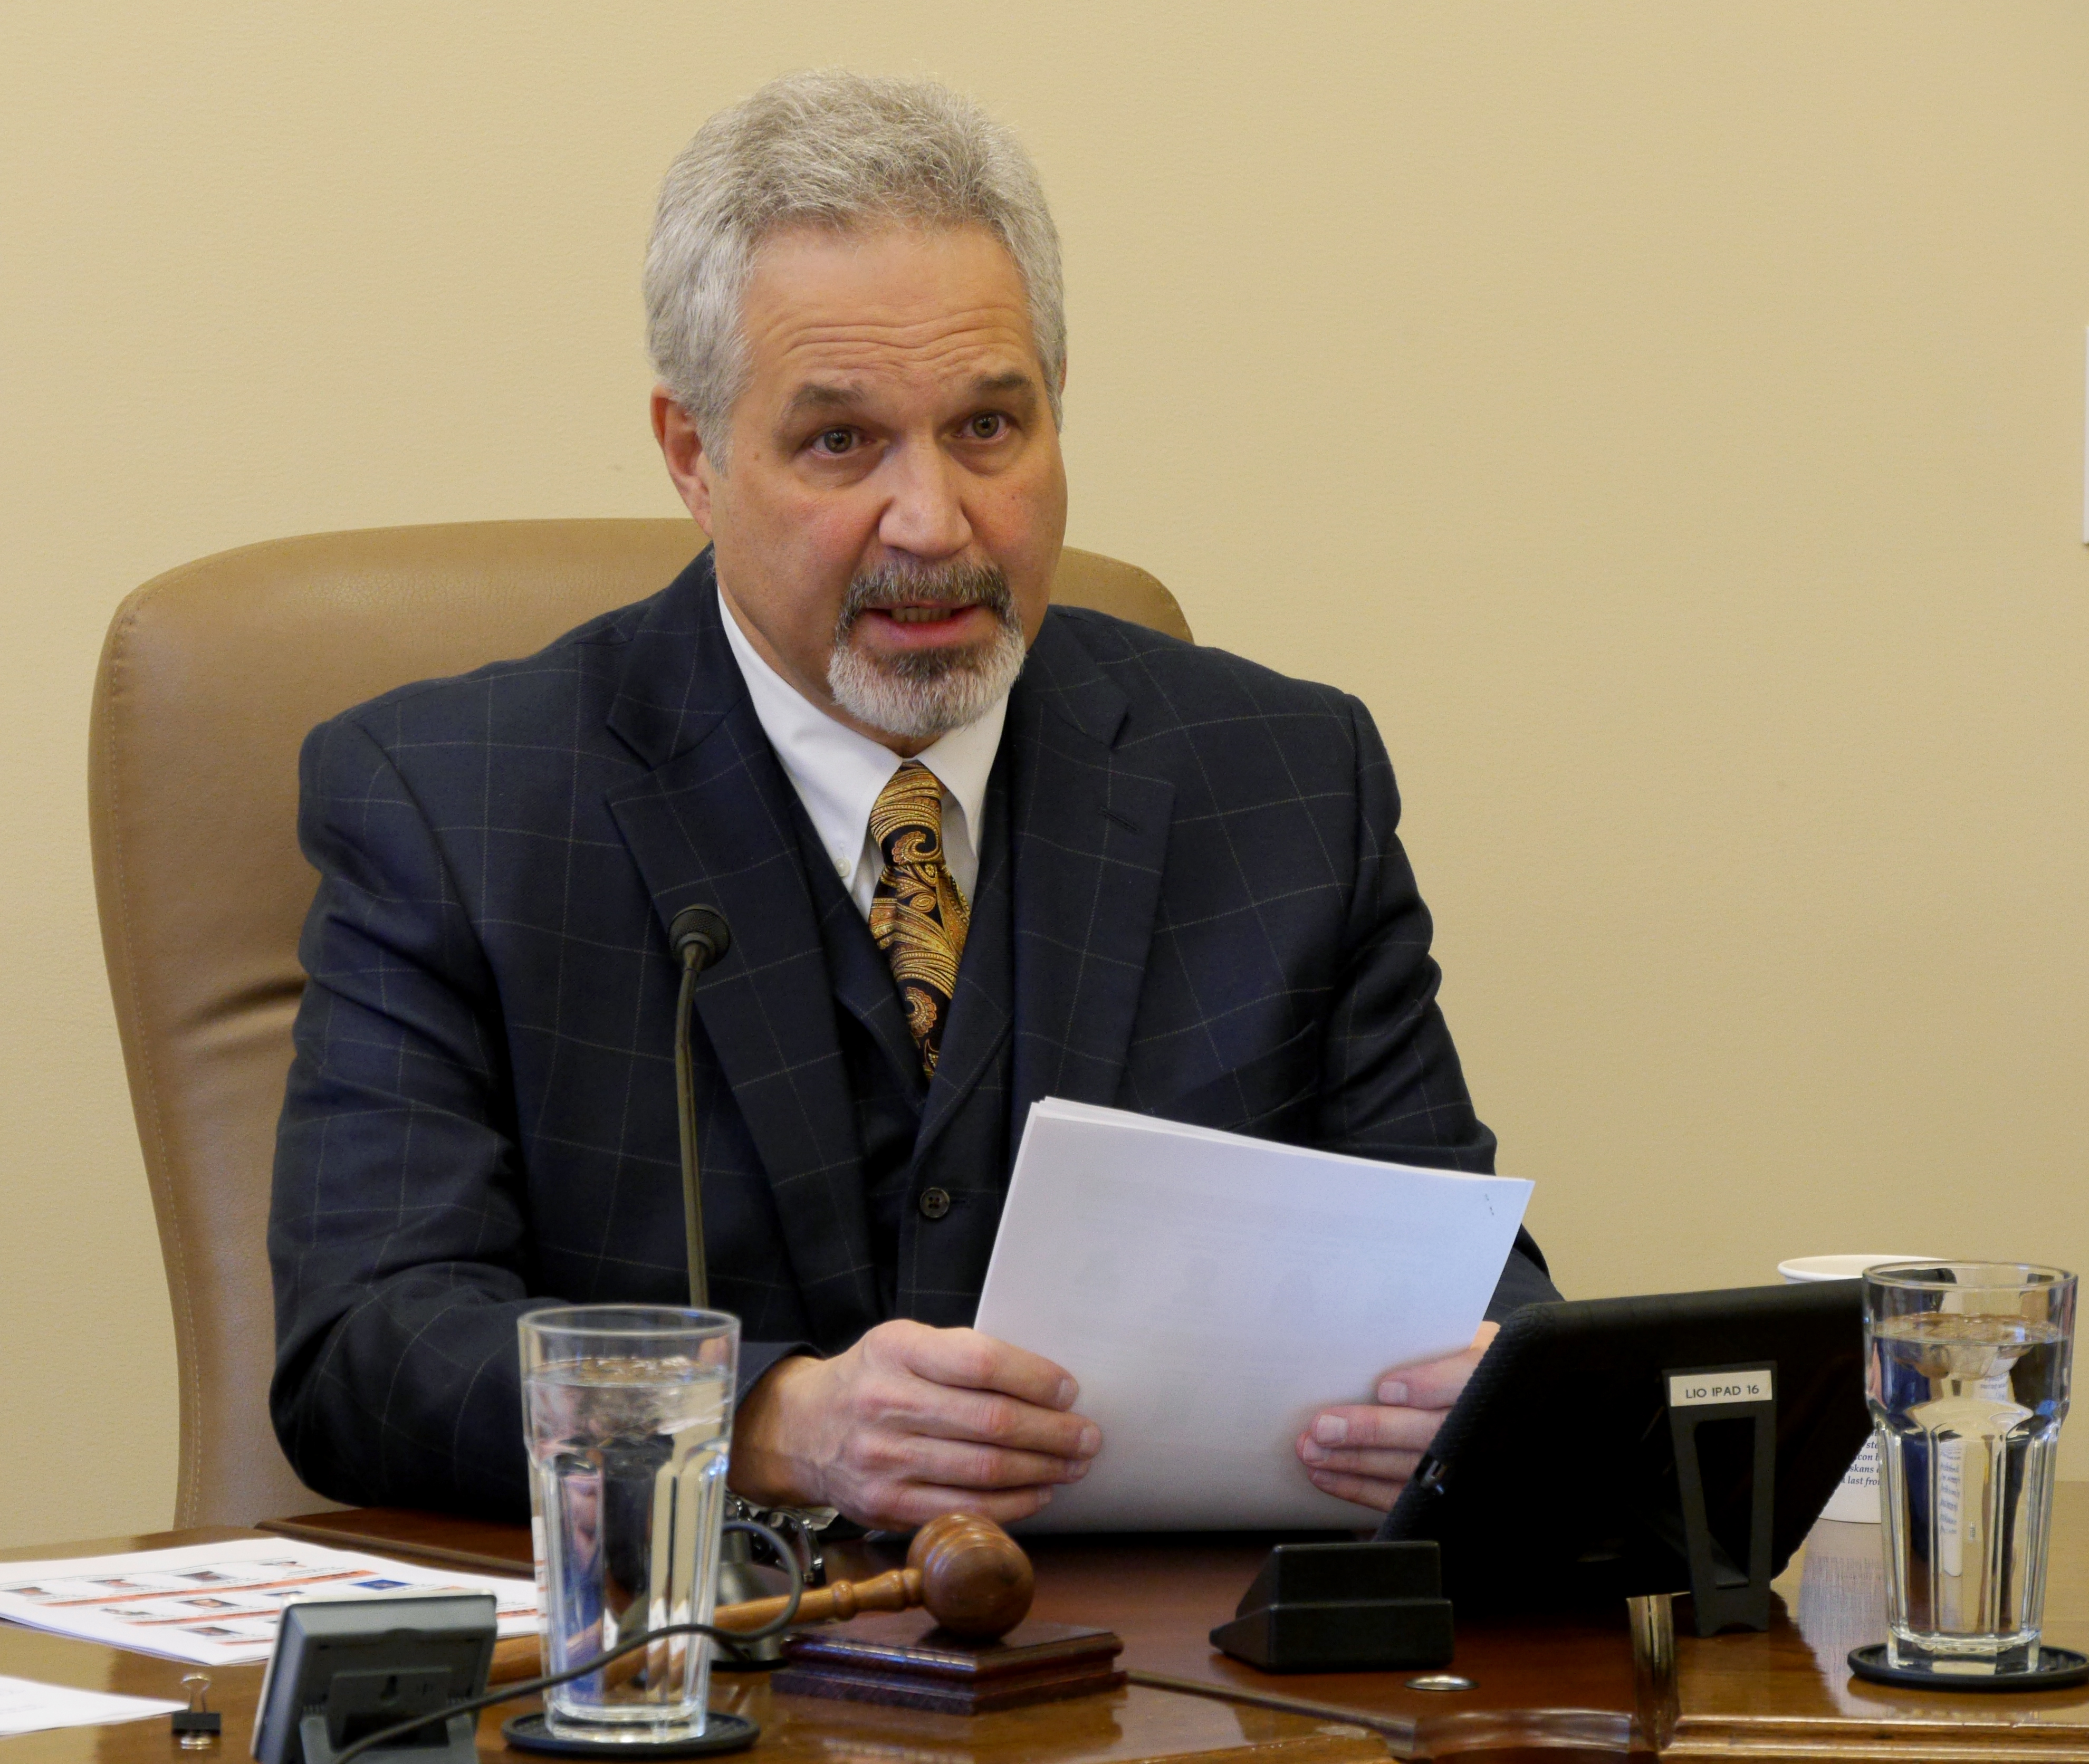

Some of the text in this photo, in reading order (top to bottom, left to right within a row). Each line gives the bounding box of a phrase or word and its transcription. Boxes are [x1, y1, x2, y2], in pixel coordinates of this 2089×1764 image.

[1685, 1384, 1759, 1399] LIO IPAD 16
[1848, 1475, 1863, 1484] last
